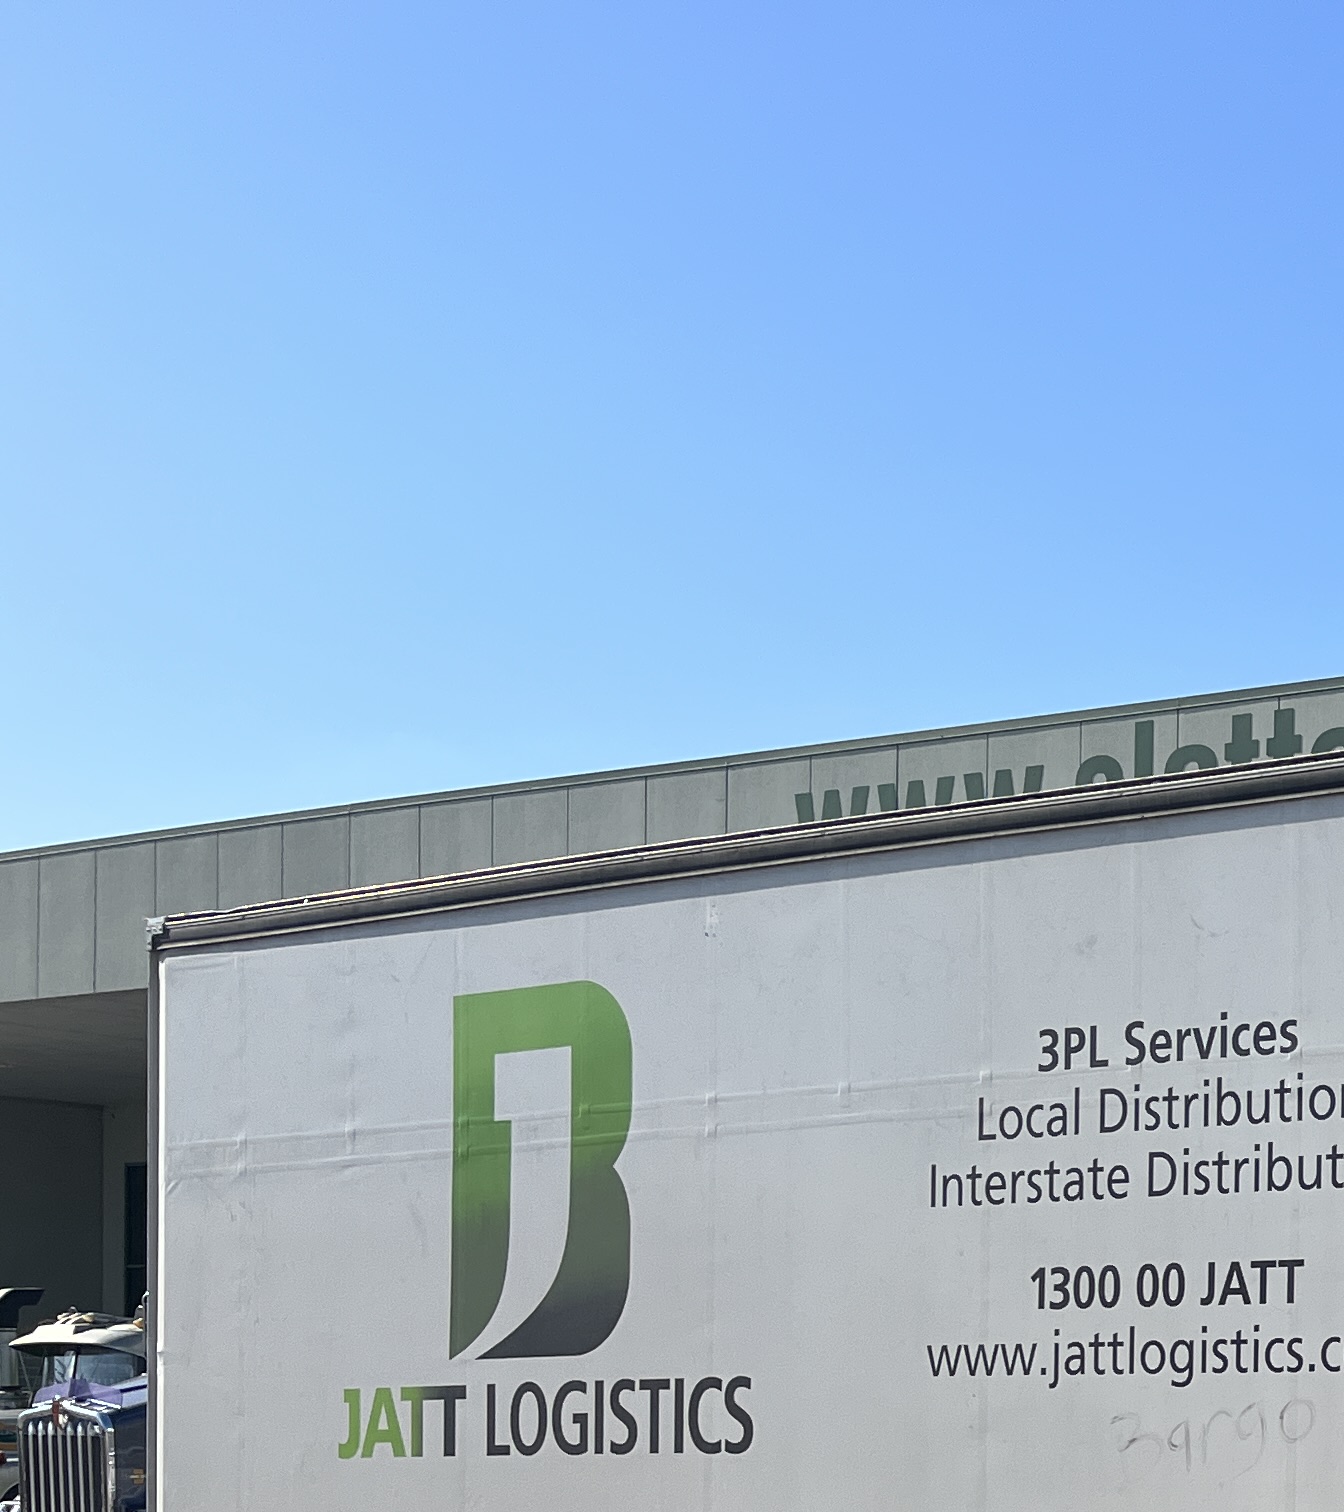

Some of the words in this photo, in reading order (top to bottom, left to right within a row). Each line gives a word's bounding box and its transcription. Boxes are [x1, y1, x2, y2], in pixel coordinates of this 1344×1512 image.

[1037, 1025, 1109, 1073] 3PL
[1124, 1011, 1299, 1066] Services
[978, 1086, 1080, 1142] Local
[930, 1157, 1130, 1208] Interstate
[1030, 1264, 1121, 1311] 1300
[1136, 1262, 1186, 1308] 00
[1199, 1258, 1305, 1307] JATT
[338, 1384, 467, 1459] JATT
[486, 1375, 754, 1457] LOGISTICS
